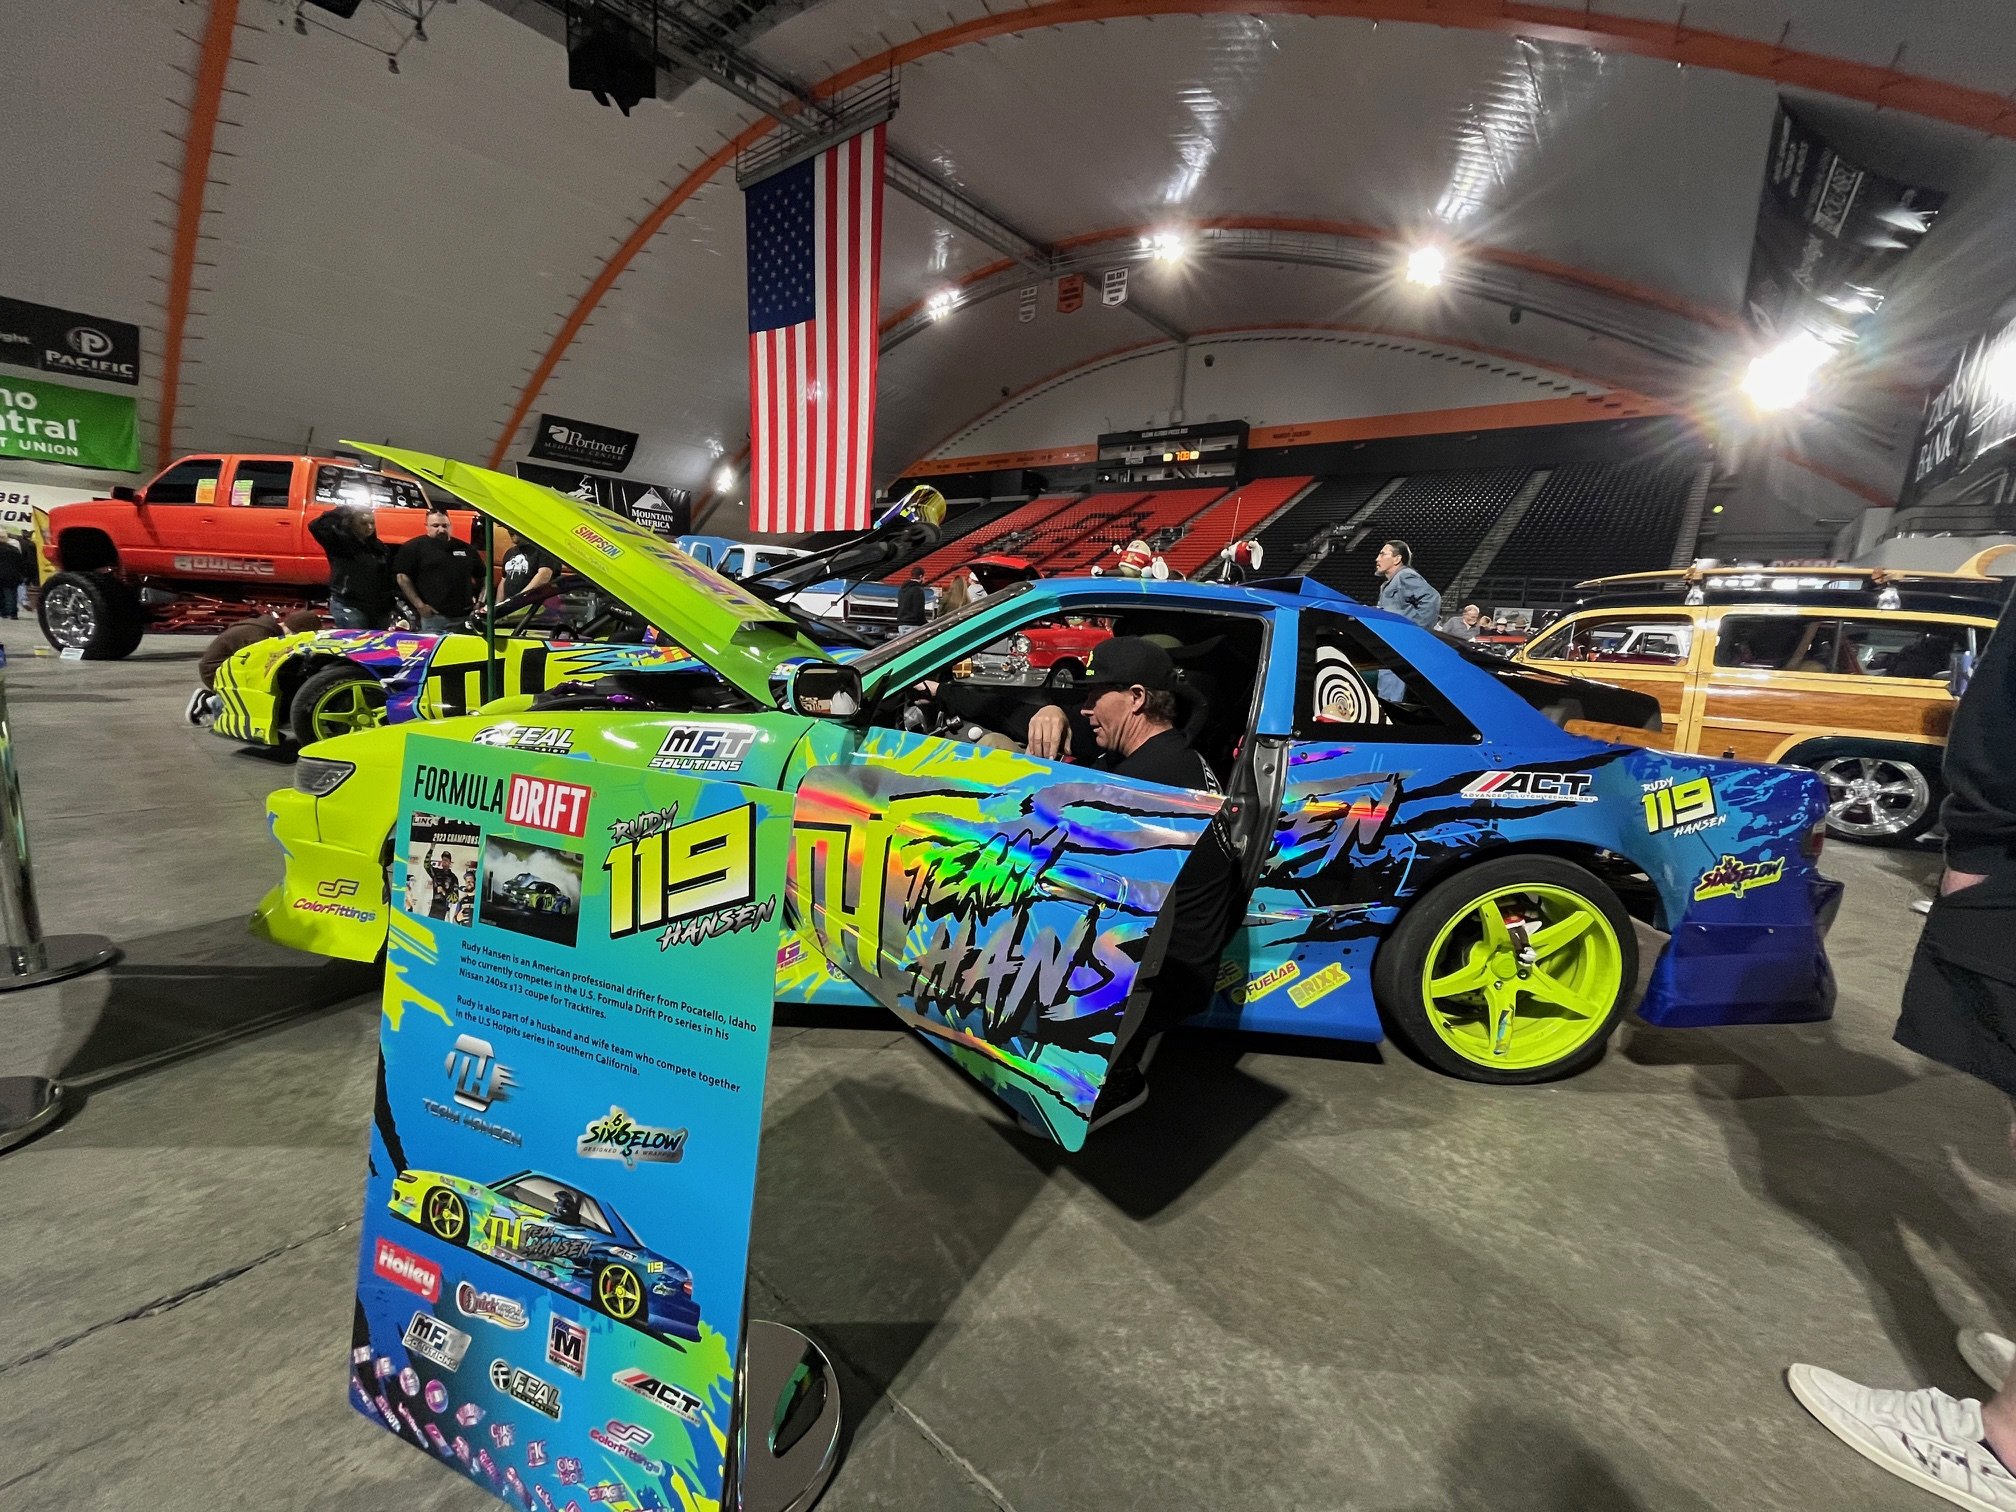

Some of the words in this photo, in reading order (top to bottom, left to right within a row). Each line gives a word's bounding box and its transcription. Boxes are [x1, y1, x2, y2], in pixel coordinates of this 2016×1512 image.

[45, 349, 134, 375] PACIFIC
[19, 438, 79, 457] UNION
[569, 430, 628, 456] Portneuf
[632, 508, 674, 522] MOUNTAIN
[635, 517, 670, 529] AMERICA
[575, 525, 620, 557] SIMPSON
[508, 726, 575, 748] FEAL
[658, 726, 757, 760] MFT
[649, 757, 743, 771] SOLUTIONS
[413, 765, 505, 814] FORMULA
[509, 777, 589, 834] DRIFT
[1493, 773, 1591, 796] ACT
[1642, 776, 1674, 792] RUDY
[608, 802, 679, 842] RUDY
[1641, 777, 1716, 834] 119
[1673, 815, 1728, 839] HANSEN
[602, 802, 757, 940] 119
[293, 897, 376, 923] ColorFittings
[659, 895, 776, 951] HANSEN
[459, 968, 484, 982] Nissan
[485, 975, 508, 989] 240sx
[509, 983, 523, 994] s13
[524, 988, 549, 1003] coupe
[550, 993, 562, 1005] for
[564, 998, 607, 1020] Tracktires.
[461, 940, 481, 955] Rudy
[482, 946, 511, 962] Hansen
[512, 954, 519, 964] is
[521, 957, 530, 968] an
[532, 960, 570, 979] American
[572, 971, 625, 994] professional
[626, 986, 655, 1003] drifter
[657, 994, 679, 1010] from
[681, 1002, 727, 1025] Pocatello,
[729, 1015, 757, 1032] Idaho
[1246, 963, 1296, 995] FUELAB
[460, 955, 477, 966] who
[478, 960, 513, 977] currently
[514, 971, 553, 989] competes
[554, 981, 562, 991] in
[564, 984, 578, 996] the
[579, 988, 595, 1001] U.S.
[597, 993, 633, 1012] Formula
[635, 1004, 656, 1018] Drift
[657, 1011, 673, 1024] Pro
[675, 1017, 702, 1032] series
[704, 1024, 713, 1036] in
[715, 1027, 729, 1040] his
[456, 1008, 463, 1018] in
[464, 1011, 477, 1021] the
[478, 1015, 490, 1027] U.S
[492, 1019, 520, 1037] Hotpits
[522, 1031, 545, 1045] series
[546, 1037, 555, 1048] in
[556, 1040, 594, 1061] southern
[596, 1053, 640, 1076] California.
[456, 994, 476, 1010] Rudy
[477, 1001, 484, 1011] is
[485, 1003, 501, 1016] also
[502, 1010, 519, 1023] part
[520, 1015, 530, 1025] of
[530, 1019, 535, 1027] a
[536, 1019, 572, 1039] husband
[573, 1034, 590, 1044] and
[591, 1038, 609, 1051] wife
[611, 1043, 634, 1059] team
[635, 1053, 655, 1065] who
[656, 1058, 697, 1079] compete
[699, 1071, 741, 1093] together
[527, 1239, 593, 1258] HANSEN
[379, 1245, 435, 1295] Holley
[647, 1262, 664, 1273] 119
[405, 1336, 458, 1371] SOLUTIONS
[512, 1370, 560, 1411] FEAL
[633, 1378, 701, 1414] ACT
[591, 1429, 661, 1474] ColorFittings
